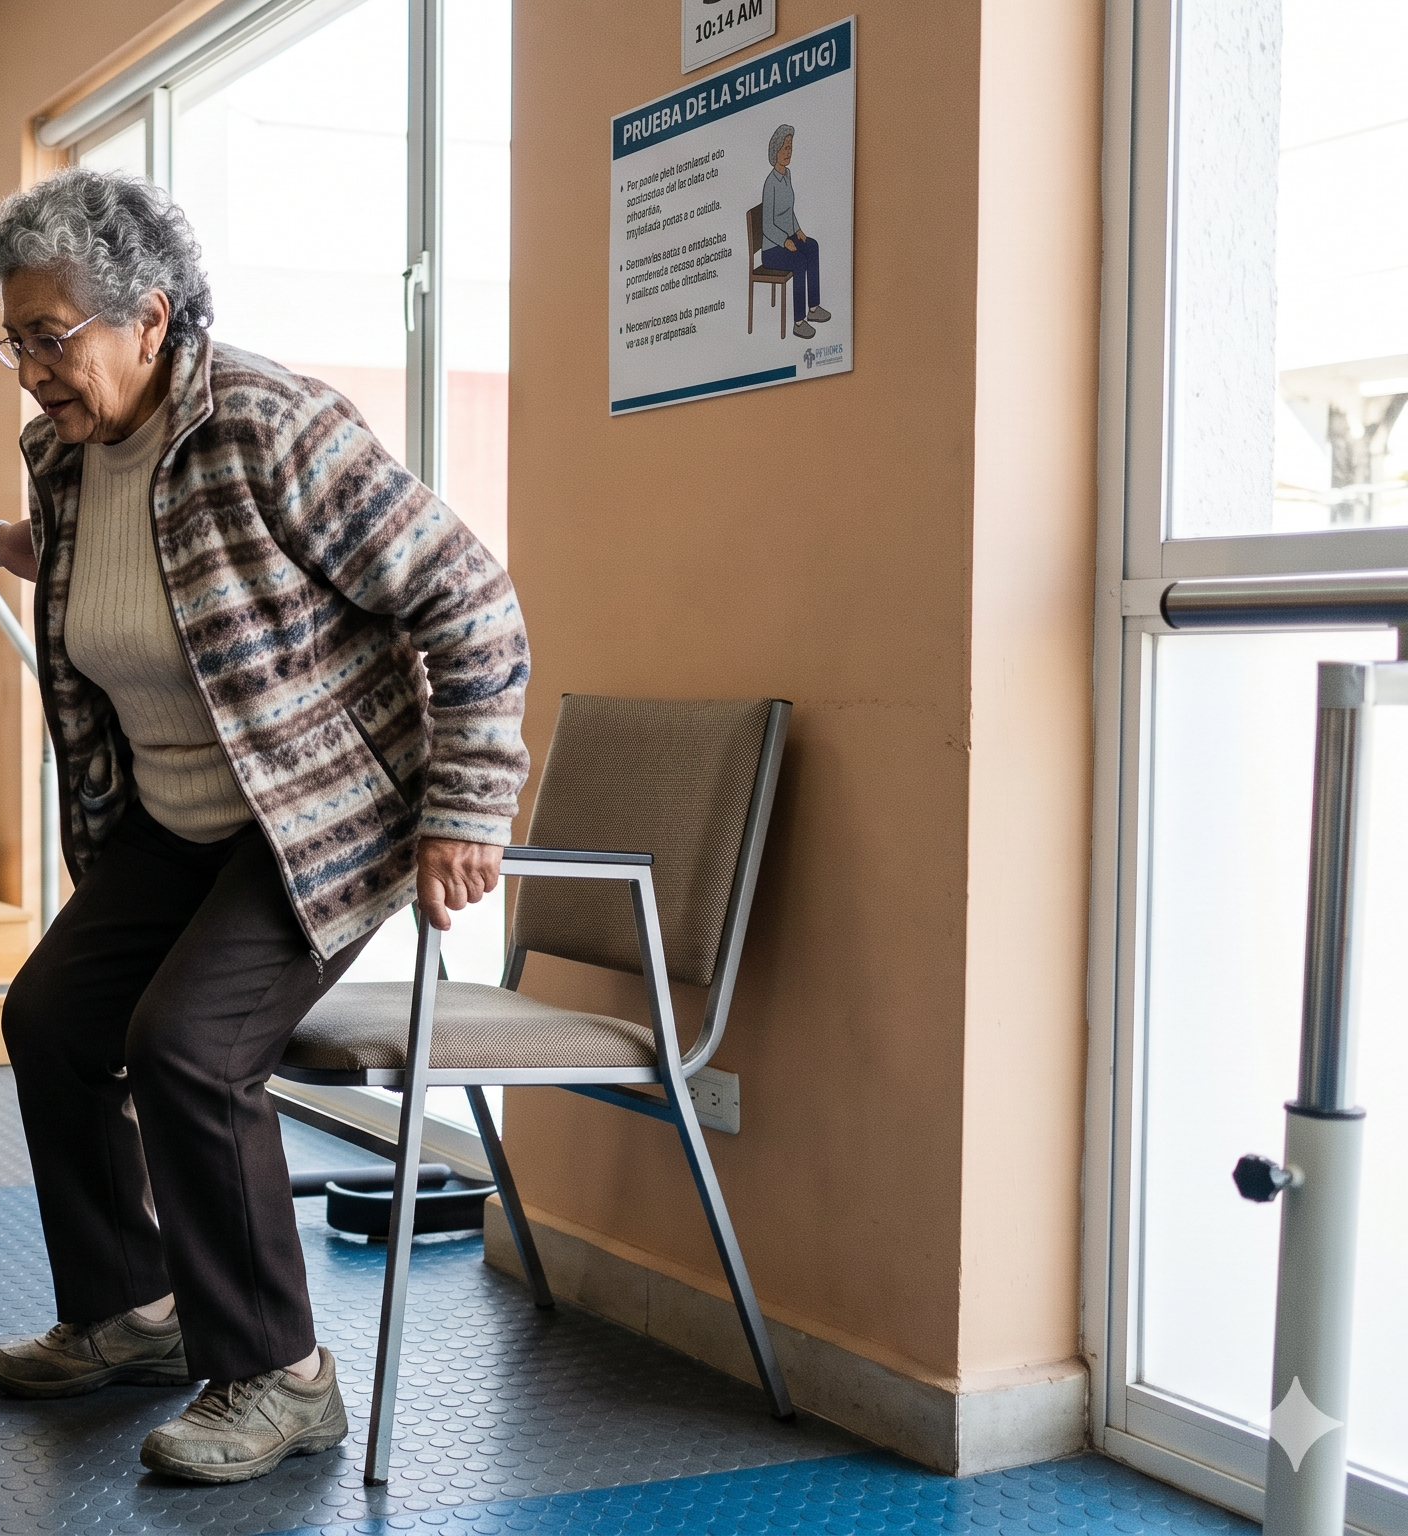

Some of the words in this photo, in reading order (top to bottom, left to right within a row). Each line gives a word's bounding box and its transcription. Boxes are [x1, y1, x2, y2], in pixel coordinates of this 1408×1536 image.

[695, 9, 735, 44] 10:14
[737, 0, 762, 26] AM
[623, 103, 682, 146] PRUEBA
[686, 92, 707, 121] DE
[710, 83, 732, 111] LA
[735, 62, 782, 101] SILLA
[786, 38, 836, 84] (TUG)
